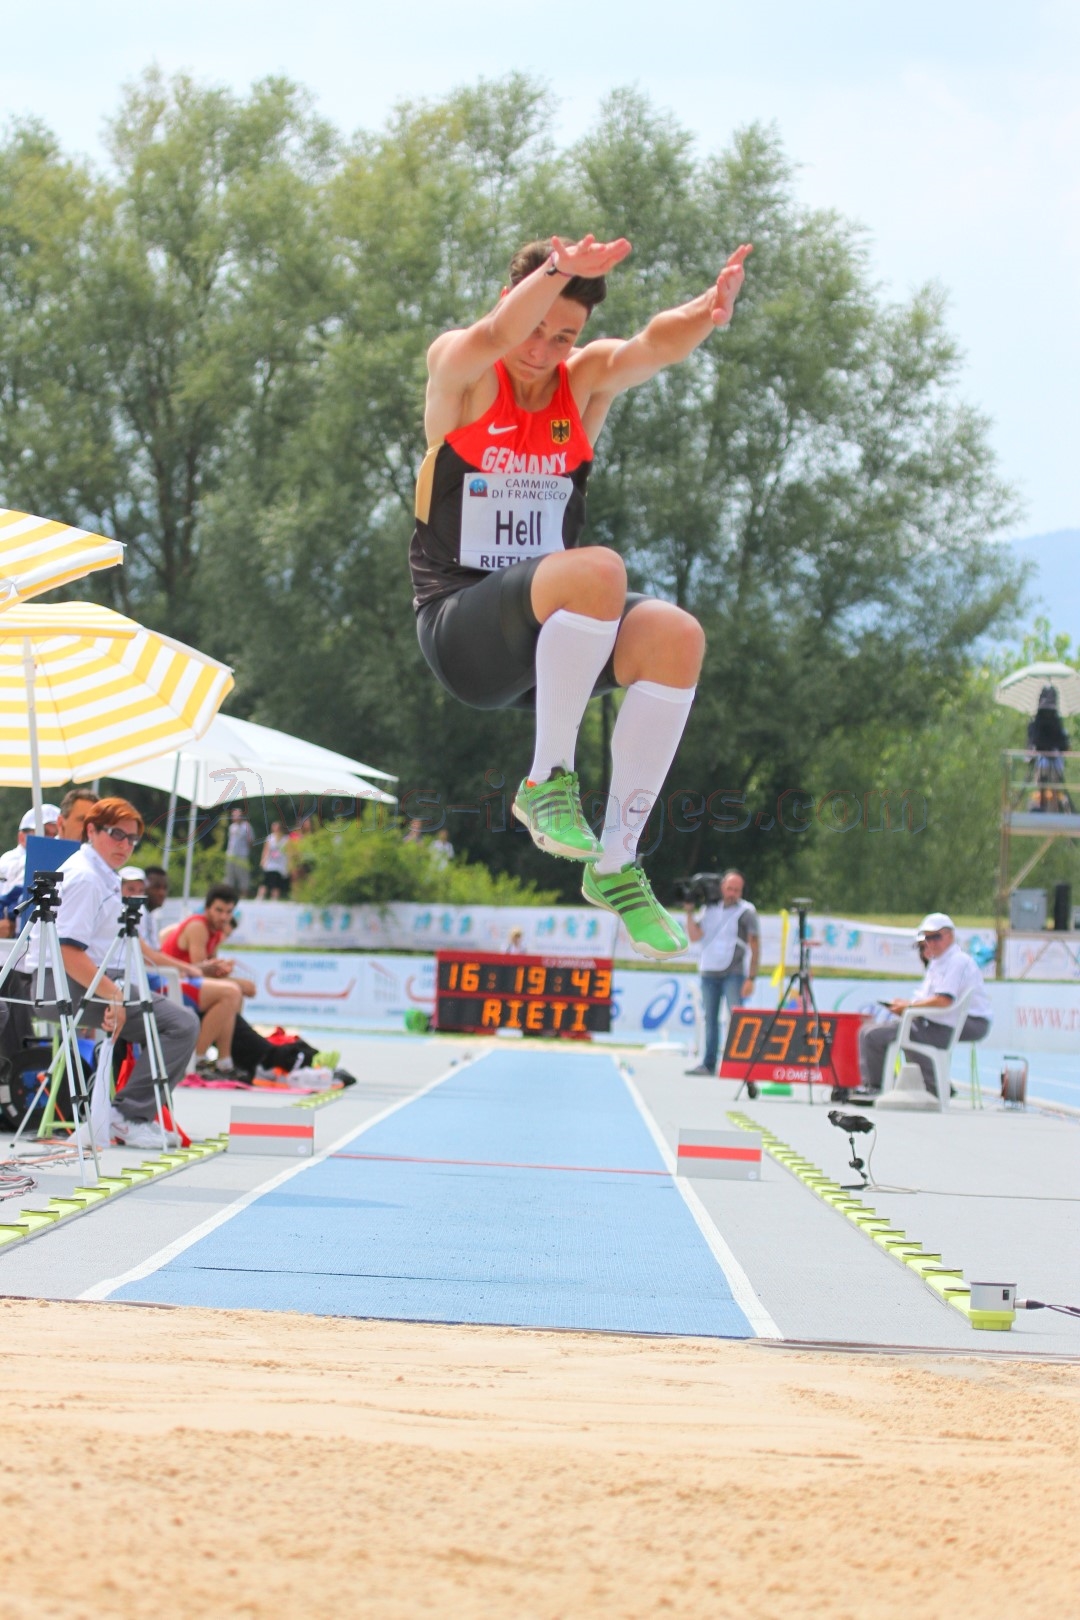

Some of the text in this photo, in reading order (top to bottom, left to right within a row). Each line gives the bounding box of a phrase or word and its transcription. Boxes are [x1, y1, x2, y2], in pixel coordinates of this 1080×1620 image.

[492, 489, 567, 501] DI FRANCESCO
[505, 478, 559, 490] CAMMINO
[495, 510, 542, 545] Hell
[481, 998, 590, 1032] RIETI
